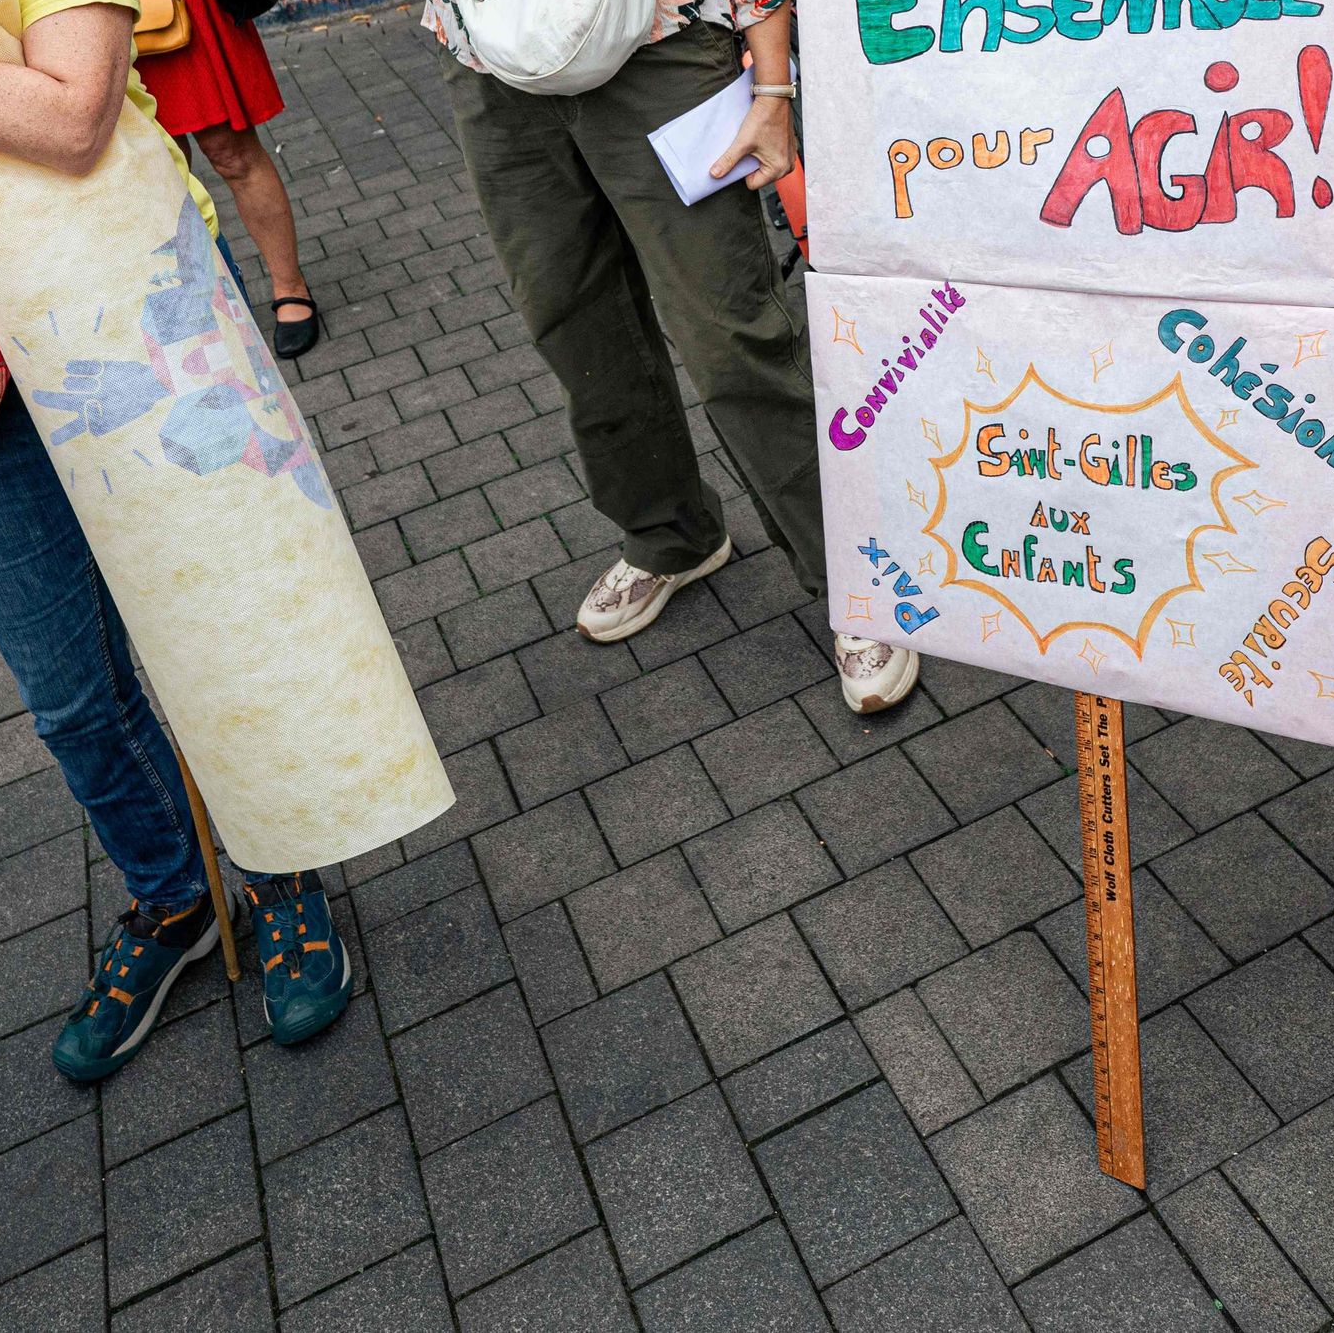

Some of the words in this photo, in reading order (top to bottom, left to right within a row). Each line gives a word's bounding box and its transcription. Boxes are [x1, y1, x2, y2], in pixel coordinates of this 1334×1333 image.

[888, 127, 1054, 219] pour
[1097, 713, 1108, 738] The
[1099, 745, 1110, 767] Set
[1101, 774, 1113, 824] Cutters
[1103, 831, 1115, 866] Cloth
[1105, 870, 1116, 901] Wolf
